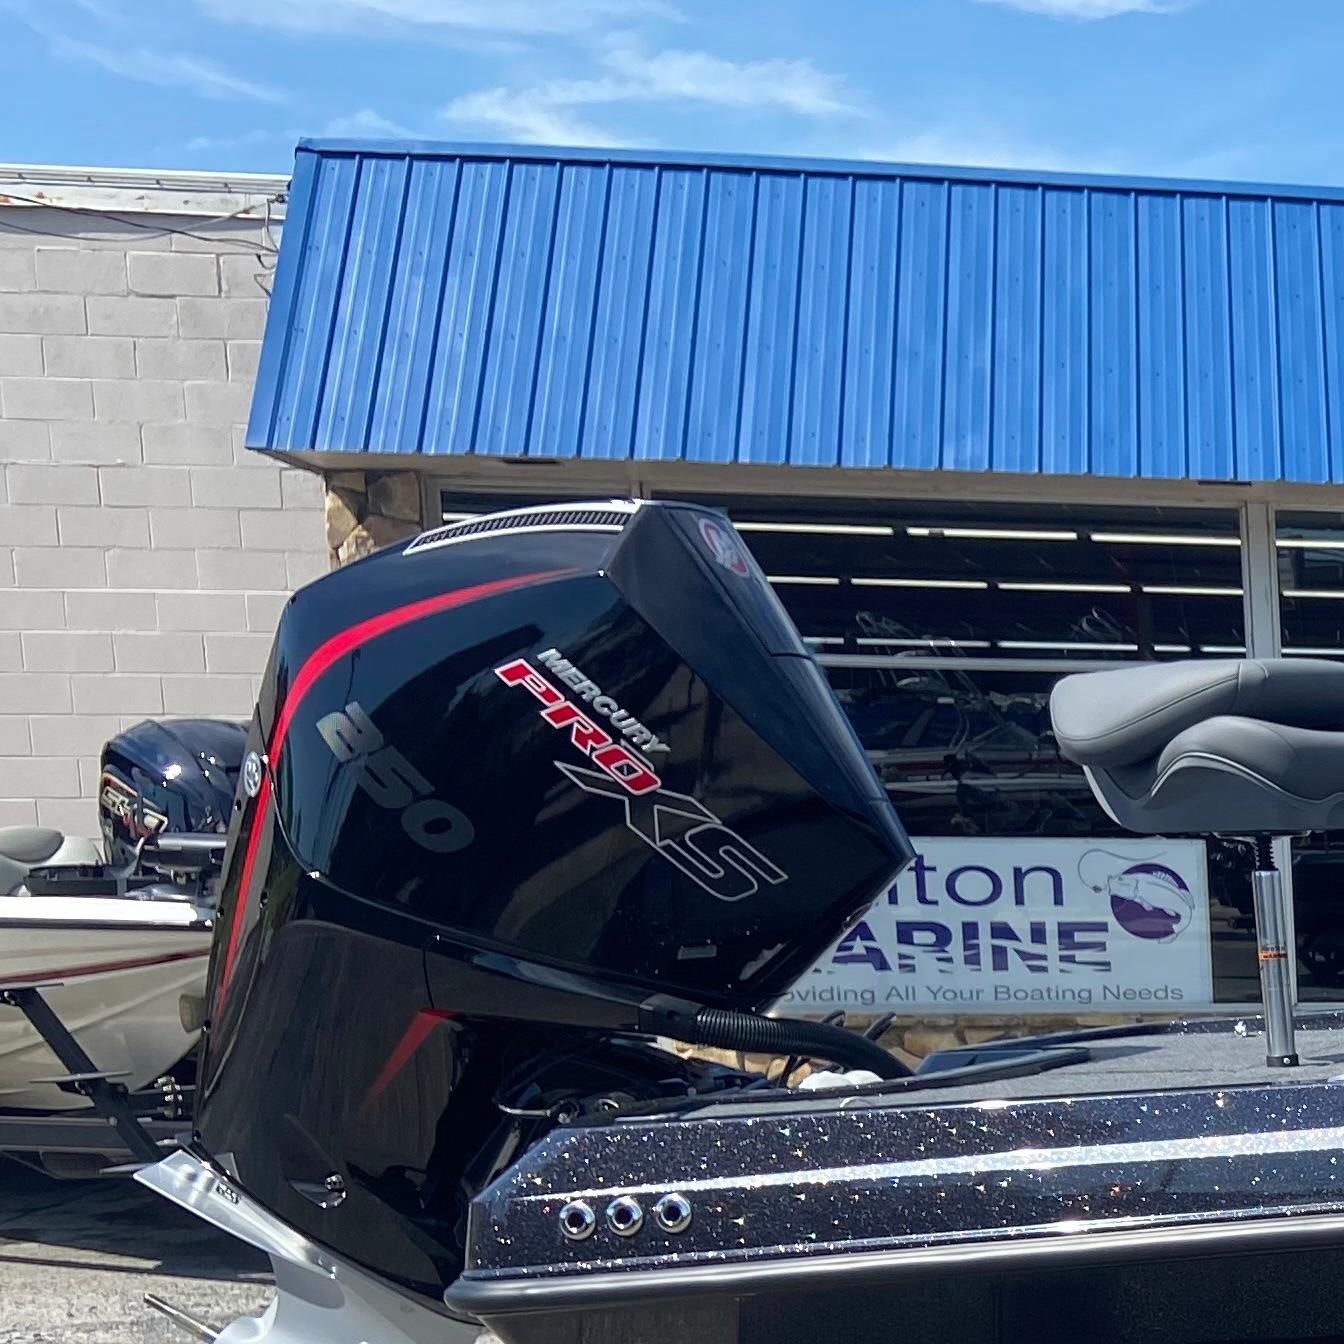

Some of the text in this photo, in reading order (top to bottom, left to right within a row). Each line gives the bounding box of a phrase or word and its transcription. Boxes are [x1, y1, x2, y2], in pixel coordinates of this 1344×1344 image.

[494, 658, 662, 796] PRO
[537, 648, 671, 753] MERCURY
[316, 701, 475, 853] 250
[553, 736, 788, 901] XS
[813, 920, 1112, 975] ARINE
[885, 984, 916, 1000] All
[926, 984, 985, 1001] Your
[994, 984, 1093, 1005] Boating
[1102, 984, 1184, 1001] Needs
